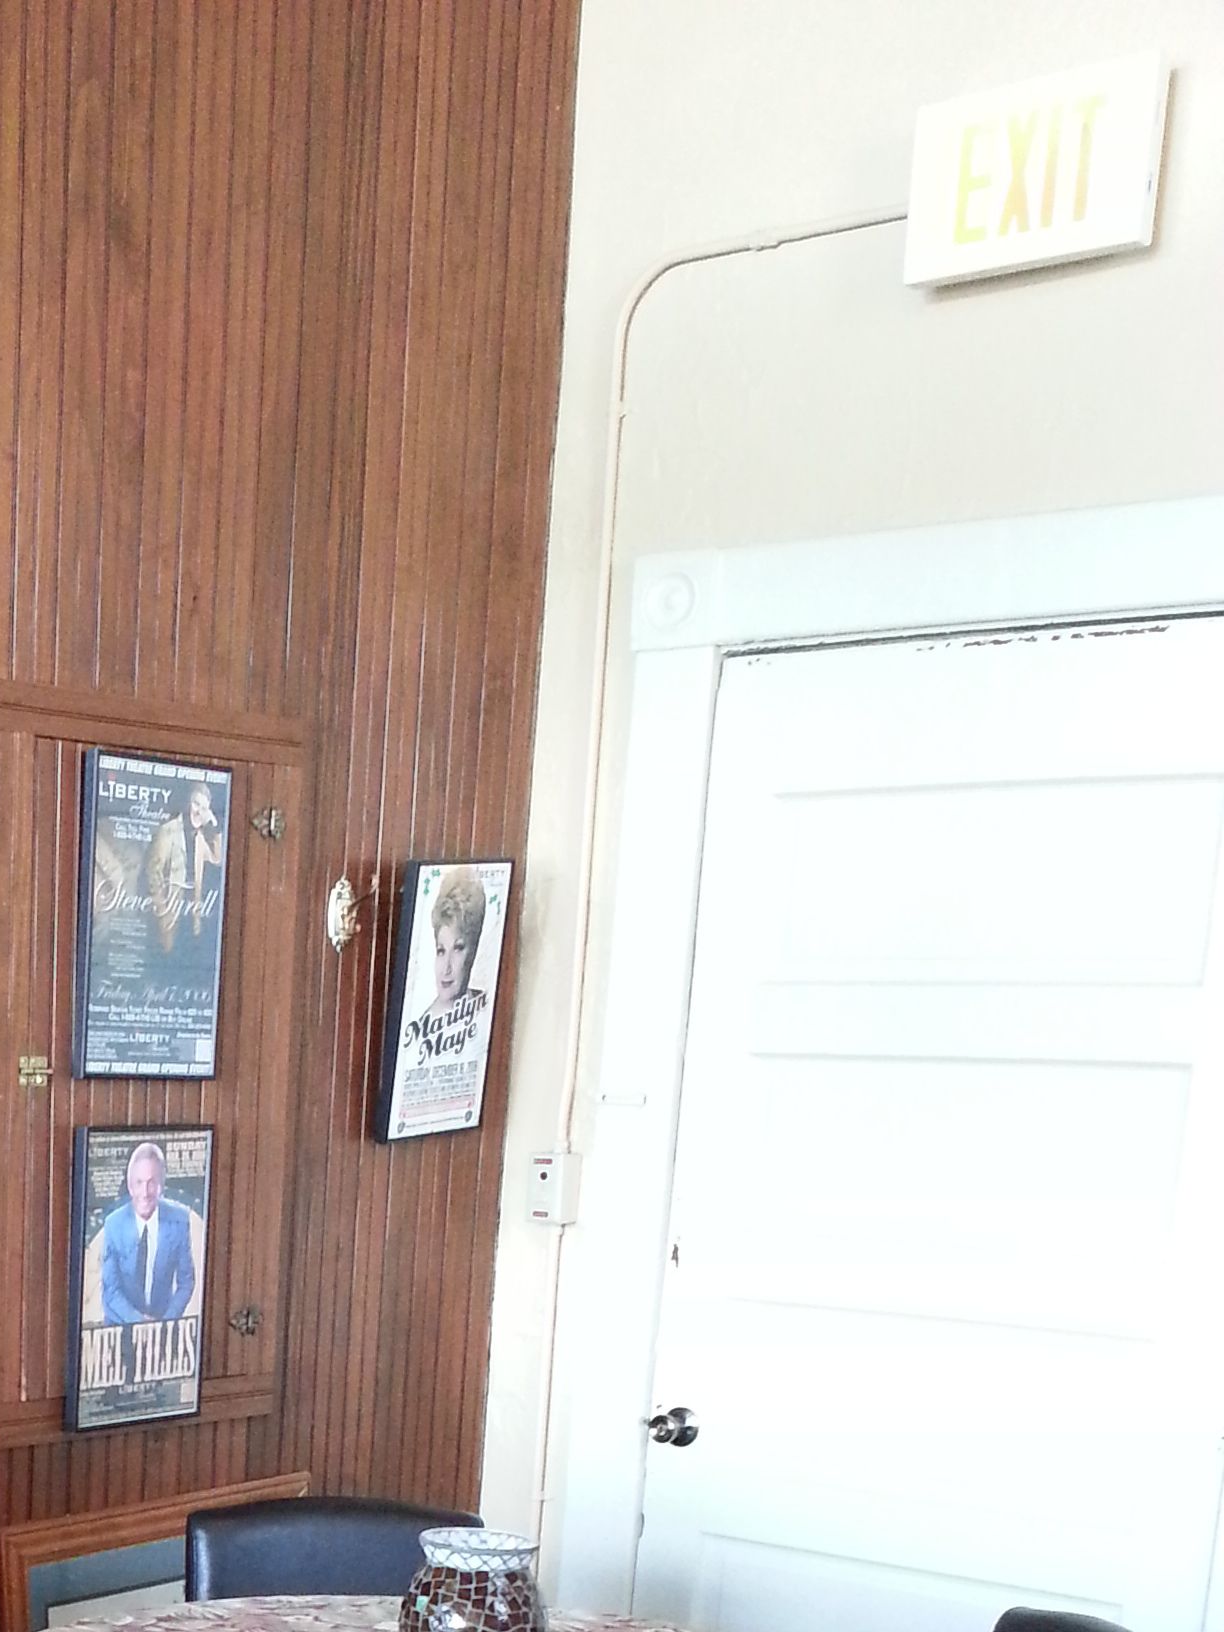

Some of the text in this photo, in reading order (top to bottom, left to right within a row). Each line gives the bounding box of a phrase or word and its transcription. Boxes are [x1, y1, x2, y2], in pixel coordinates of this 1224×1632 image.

[953, 95, 1108, 245] EXIT
[98, 780, 172, 804] LIBERTY
[129, 801, 171, 821] Theatre
[95, 879, 153, 913] Steve
[153, 880, 218, 930] Tyrell
[129, 1032, 170, 1044] LIBERTY
[404, 992, 488, 1049] Marilyn
[417, 1021, 478, 1067] Maye
[79, 1317, 197, 1391] MEL TILLIS
